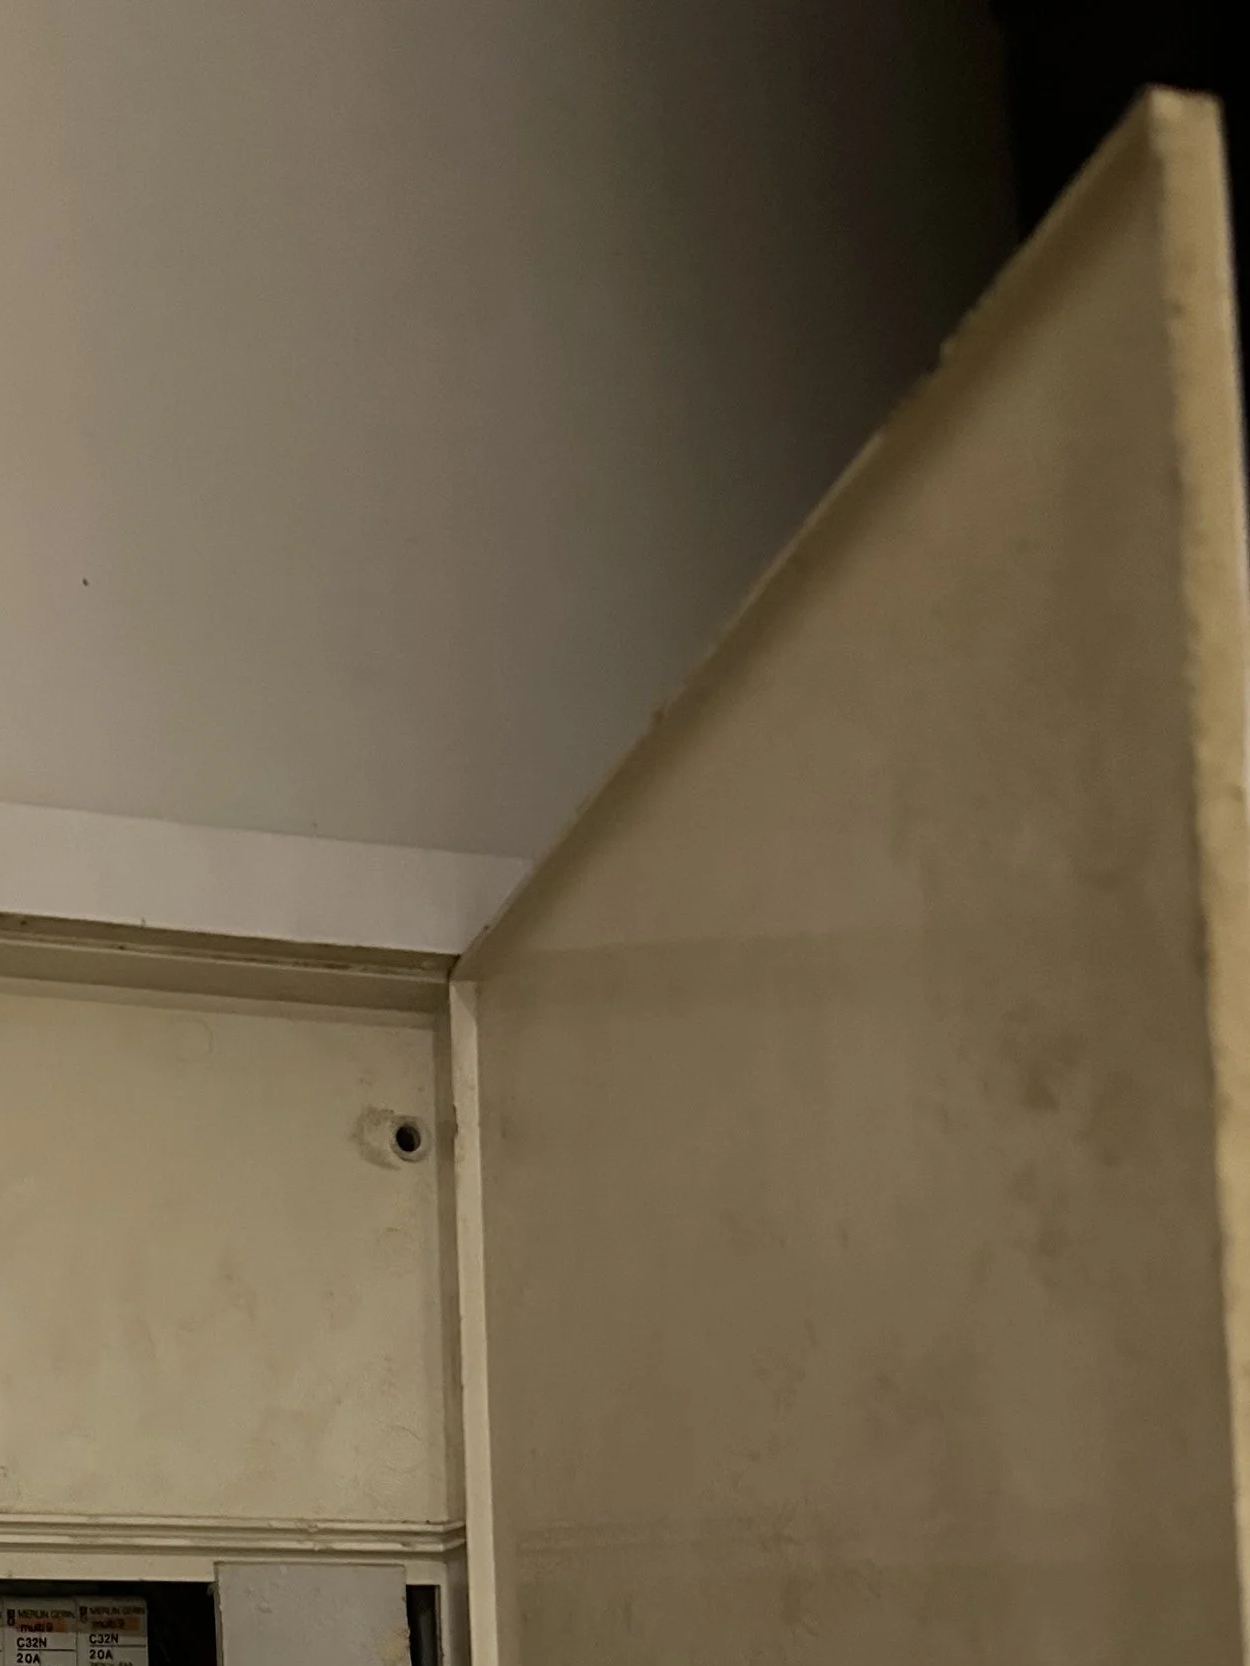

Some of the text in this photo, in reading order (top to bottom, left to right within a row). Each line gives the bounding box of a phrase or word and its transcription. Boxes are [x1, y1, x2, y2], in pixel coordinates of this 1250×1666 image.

[16, 1637, 47, 1648] C32N
[89, 1633, 119, 1644] C32N
[16, 1653, 41, 1664] 20A
[89, 1649, 114, 1661] 20A
